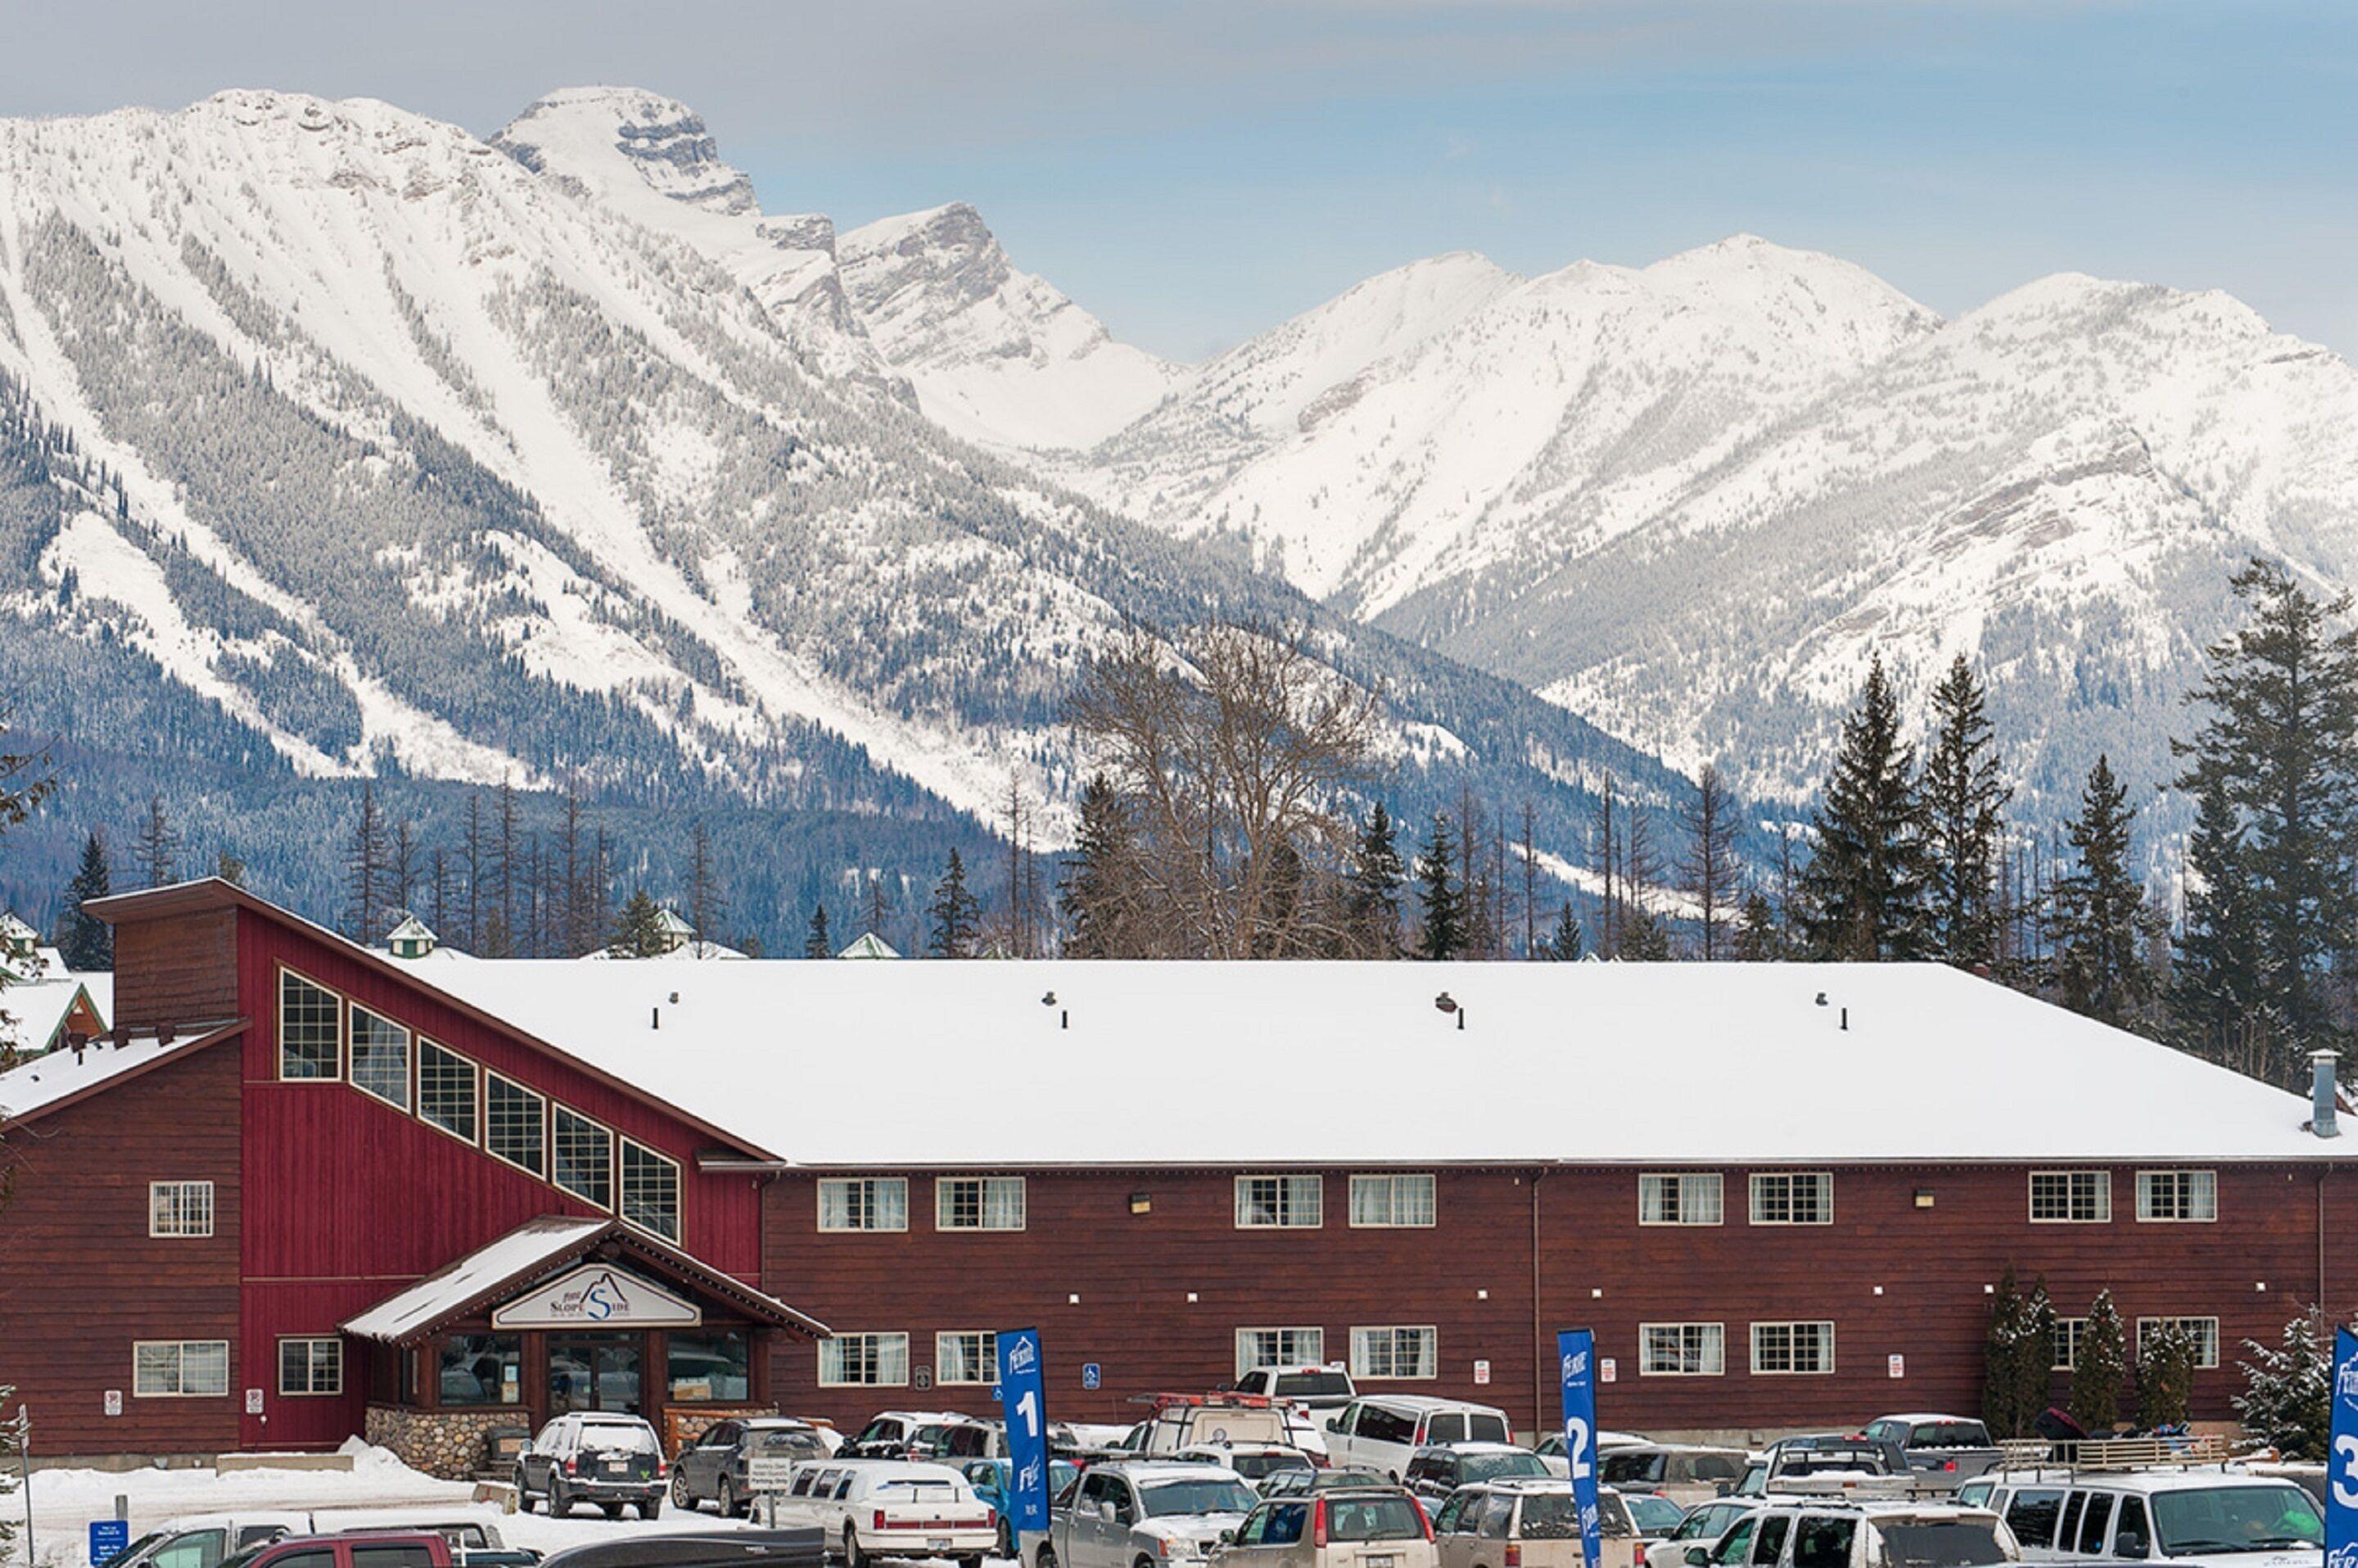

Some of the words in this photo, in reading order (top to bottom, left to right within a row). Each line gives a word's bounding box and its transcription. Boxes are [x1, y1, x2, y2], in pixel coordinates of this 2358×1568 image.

[1016, 1390, 1038, 1438] 1
[1566, 1417, 1590, 1480] 2
[2333, 1434, 2358, 1510] 3
